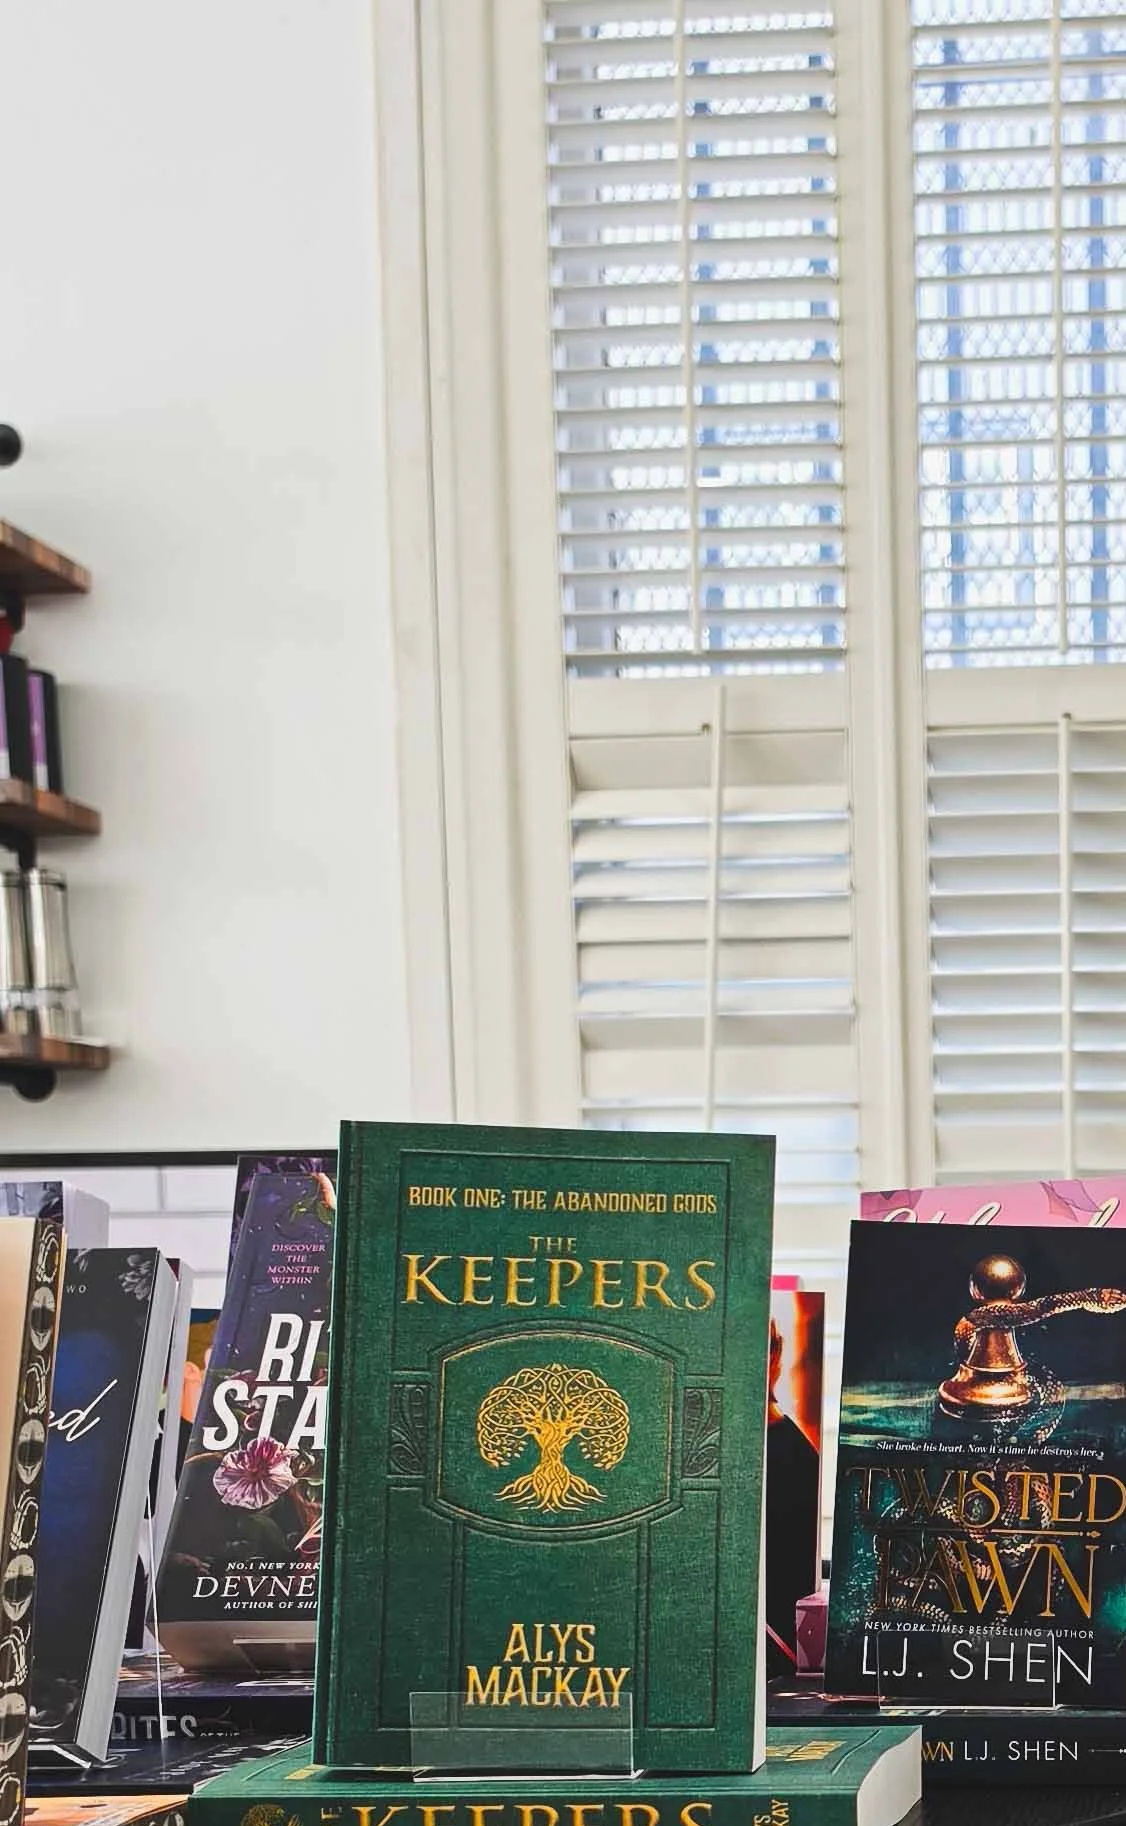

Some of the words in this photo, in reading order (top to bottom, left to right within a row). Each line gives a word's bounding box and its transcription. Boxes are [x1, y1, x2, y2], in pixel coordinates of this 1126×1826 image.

[408, 1186, 457, 1207] BOOK
[464, 1188, 506, 1208] ONE:
[511, 1189, 547, 1211] THE
[553, 1190, 667, 1214] ABANDONED
[672, 1193, 718, 1215] GODS
[271, 1243, 326, 1252] DISCOVER
[528, 1235, 577, 1254] THE
[287, 1254, 307, 1263] THE
[266, 1265, 321, 1275] MONSTER
[271, 1276, 313, 1285] WITHIN
[66, 1285, 87, 1294] WO
[401, 1253, 717, 1311] KEEPERS
[255, 1312, 331, 1383] RI
[202, 1379, 329, 1451] STA
[876, 1440, 894, 1451] She
[895, 1440, 922, 1452] broke
[922, 1441, 937, 1452] his
[938, 1442, 966, 1453] heart.
[968, 1443, 988, 1454] Now
[1004, 1445, 1026, 1456] time
[1027, 1445, 1040, 1456] he
[1040, 1446, 1079, 1459] destroys
[258, 1561, 286, 1571] NEW
[289, 1561, 321, 1571] YORK
[192, 1575, 316, 1598] DEVNE
[875, 1536, 1100, 1618] PAWN
[223, 1601, 275, 1610] AUTHOR
[278, 1601, 294, 1609] OF
[297, 1601, 319, 1609] SHI
[864, 1620, 891, 1631] NEW
[896, 1622, 926, 1633] YORK
[931, 1624, 965, 1635] TIMES
[968, 1625, 1043, 1638] BESTSELLING
[1047, 1629, 1095, 1640] AUTHOR
[502, 1623, 597, 1664] ALYS
[862, 1635, 924, 1679] L.J.
[949, 1639, 1094, 1685] SHEN
[464, 1665, 631, 1708] MACKAY
[921, 1740, 955, 1762] WN
[964, 1740, 996, 1761] L.J.
[1007, 1740, 1079, 1761] SHEN
